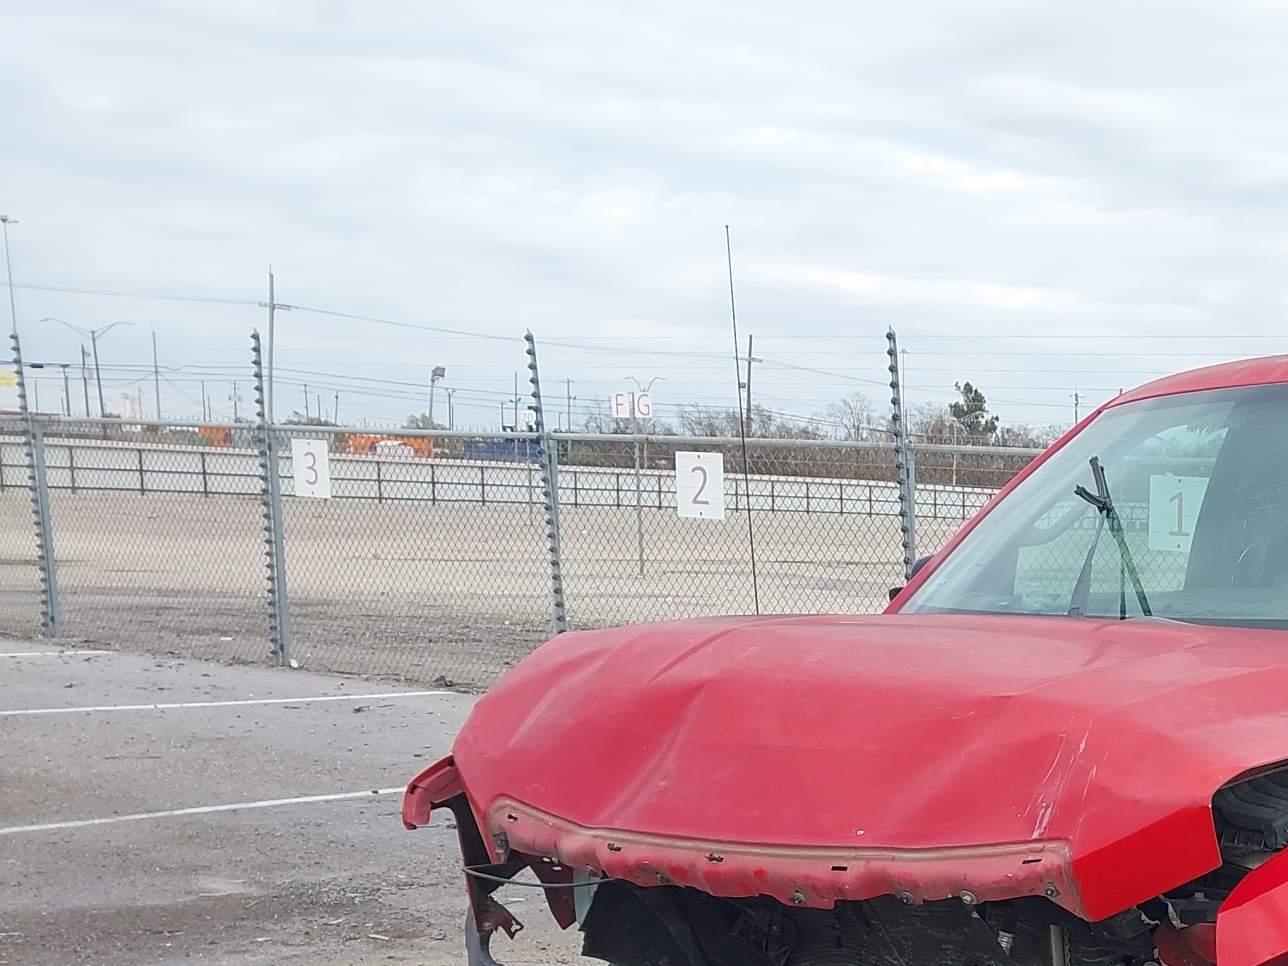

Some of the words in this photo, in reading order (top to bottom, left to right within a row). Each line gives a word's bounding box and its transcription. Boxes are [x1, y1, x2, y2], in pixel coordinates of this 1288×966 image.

[615, 393, 625, 416] F
[637, 394, 650, 416] G
[304, 451, 318, 485] 3
[691, 465, 708, 506] 2
[1168, 491, 1190, 537] 1
